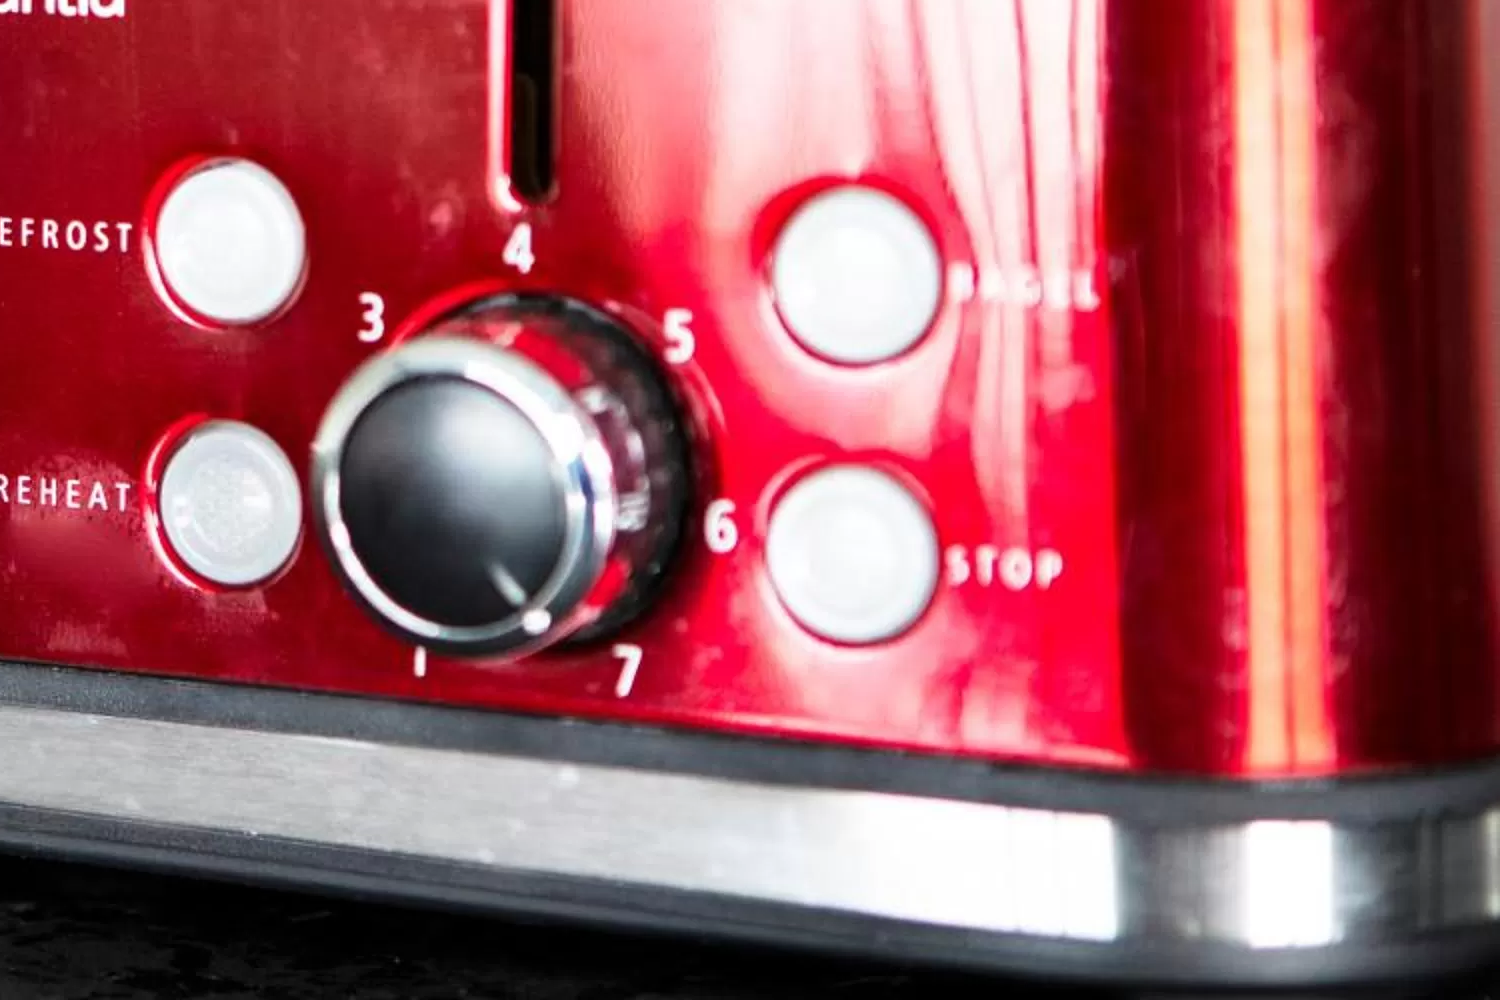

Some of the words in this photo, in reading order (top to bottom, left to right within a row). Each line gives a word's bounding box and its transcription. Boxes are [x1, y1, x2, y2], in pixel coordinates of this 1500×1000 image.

[502, 223, 534, 273] 4
[357, 292, 385, 342] 3
[663, 308, 695, 364] 5
[704, 499, 738, 553] 6
[944, 543, 1063, 590] STOP
[612, 645, 643, 698] 7
